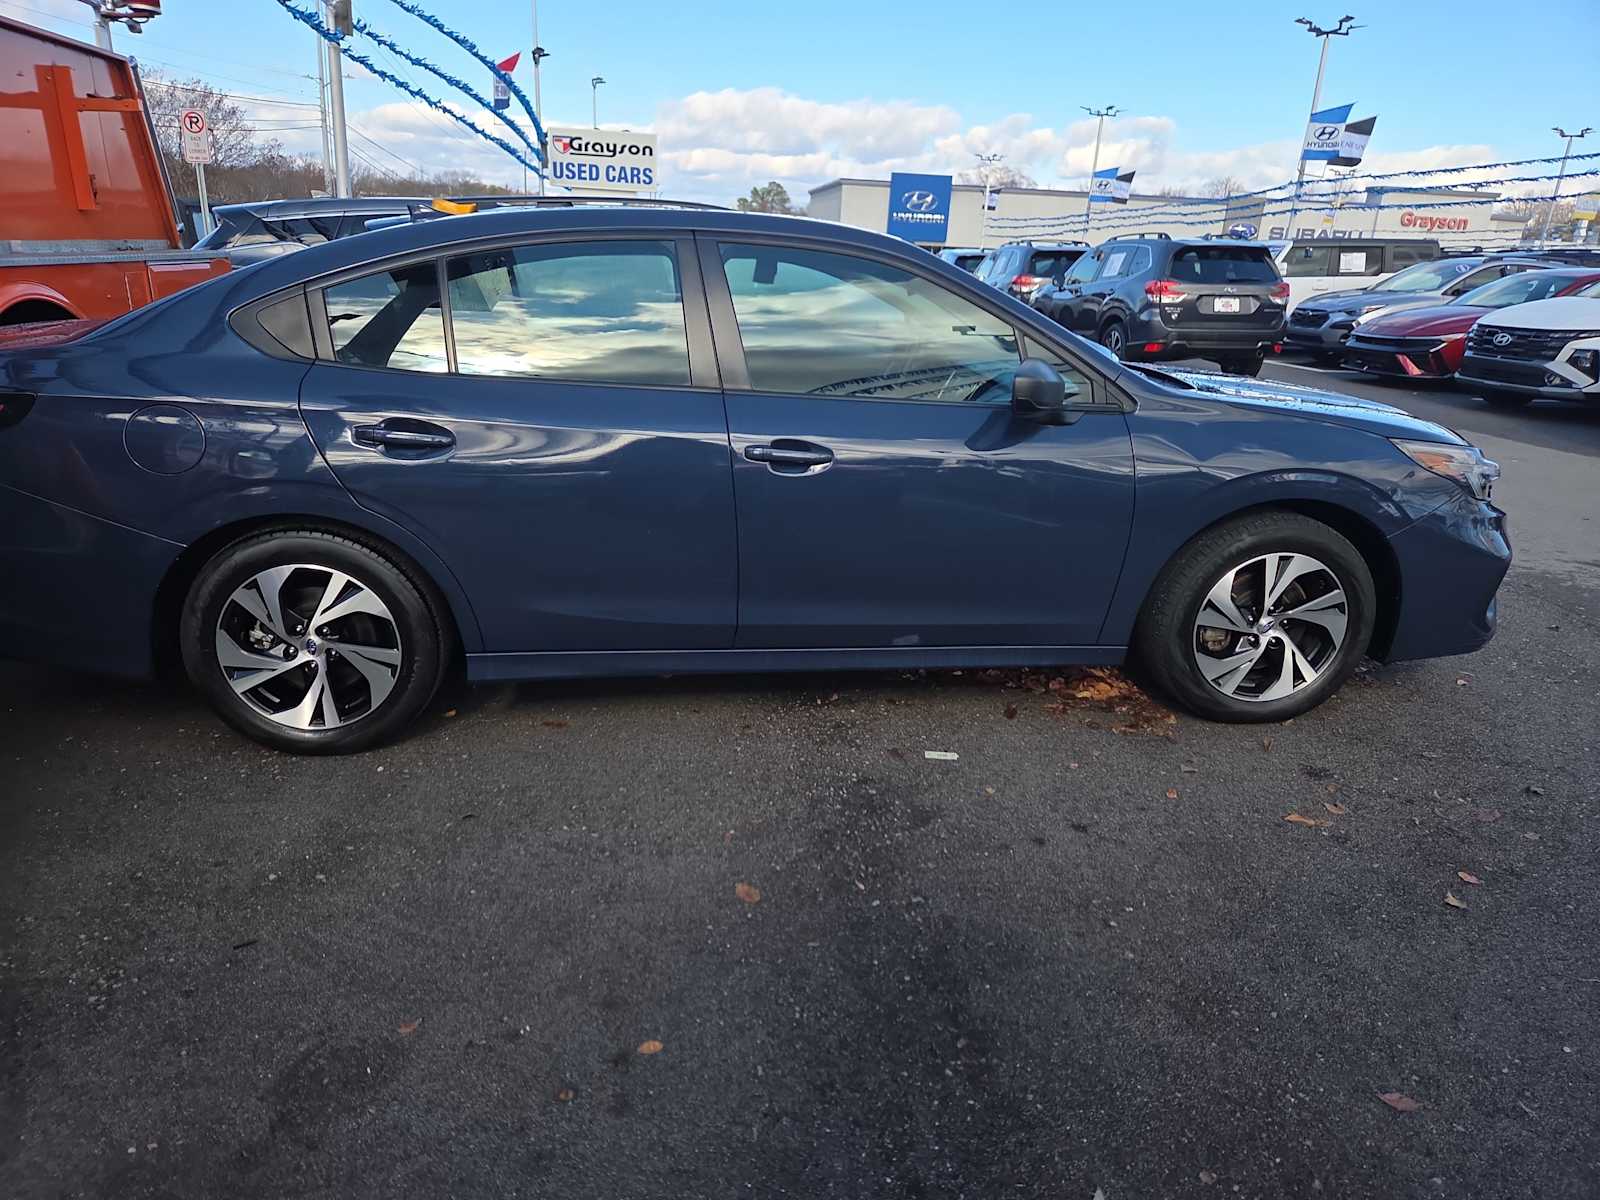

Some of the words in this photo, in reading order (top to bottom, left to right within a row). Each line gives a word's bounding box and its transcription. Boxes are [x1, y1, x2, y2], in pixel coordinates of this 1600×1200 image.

[569, 137, 653, 157] Grayson
[553, 161, 600, 181] USED
[605, 165, 653, 185] CARS
[893, 212, 945, 224] HYUNDAI
[1400, 211, 1469, 232] Grayson
[1269, 226, 1365, 240] SUBARU
